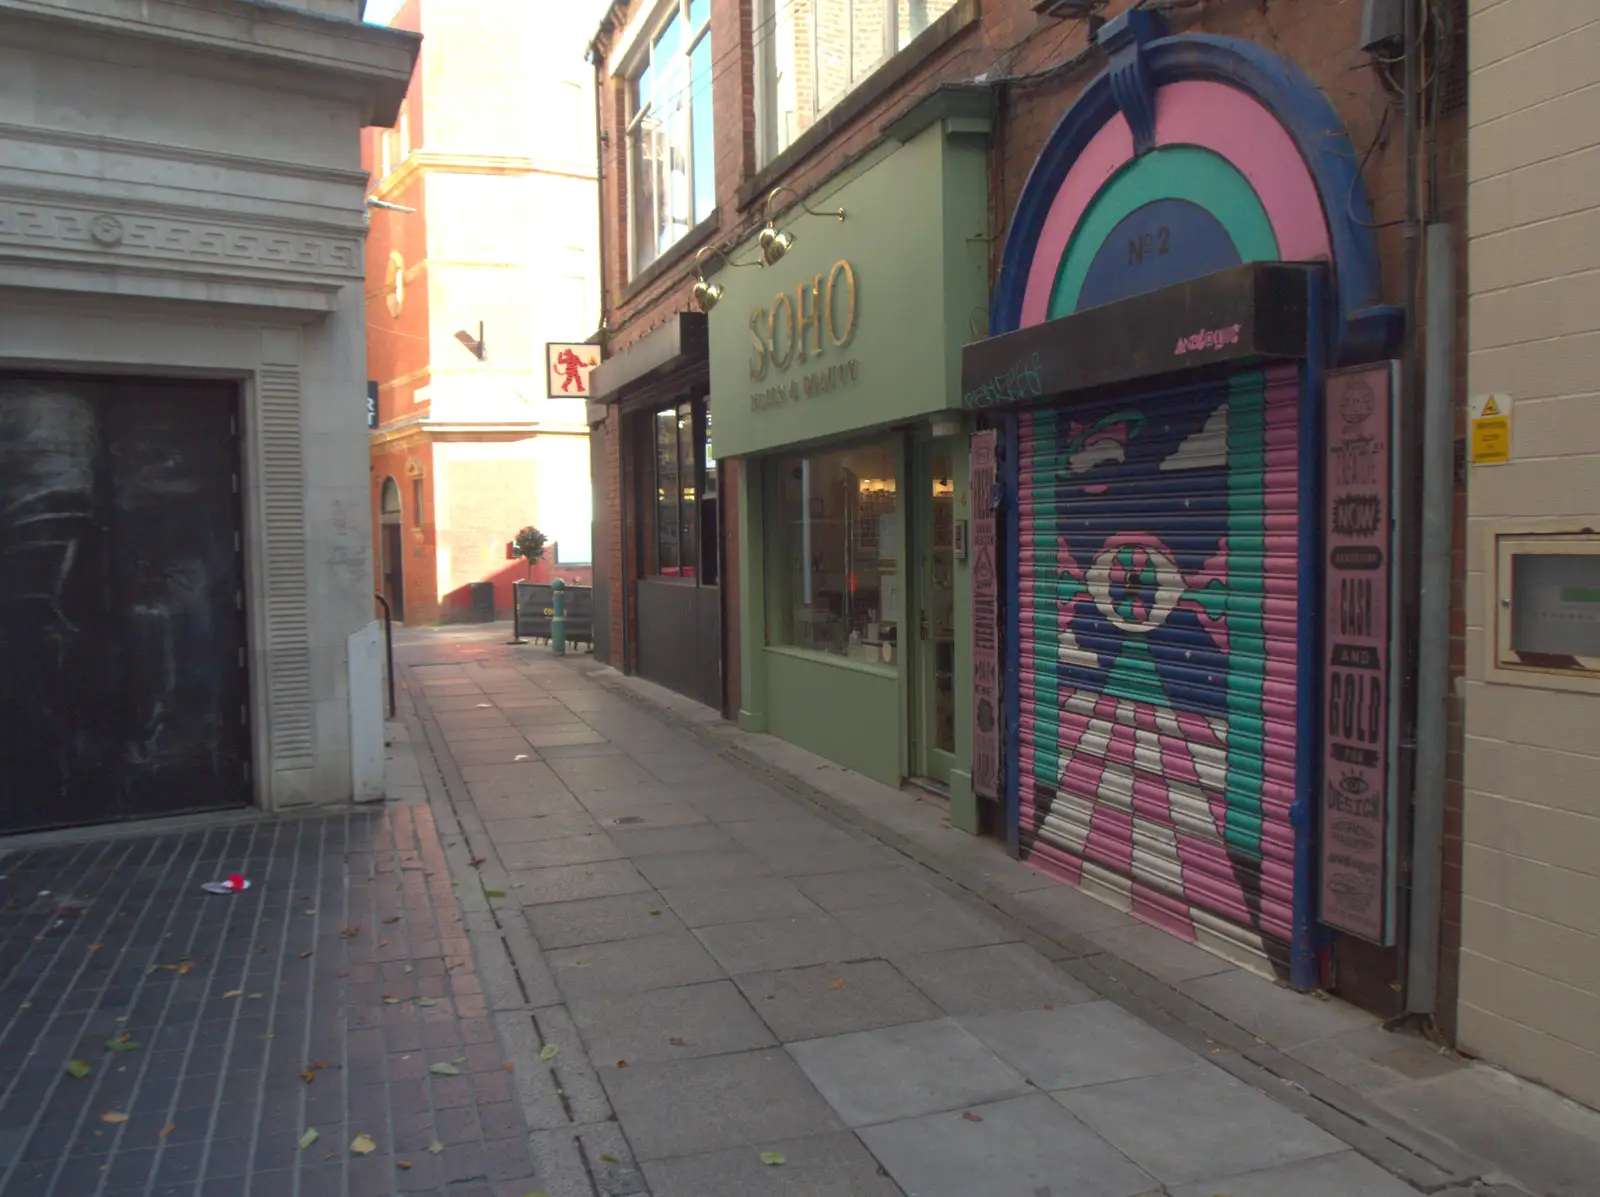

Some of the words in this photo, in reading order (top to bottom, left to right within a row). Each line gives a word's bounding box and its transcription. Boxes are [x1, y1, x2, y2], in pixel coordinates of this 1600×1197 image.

[749, 259, 855, 381] SOHO
[1340, 647, 1371, 664] AND
[1329, 671, 1382, 744] GOLD
[1327, 778, 1380, 821] DESIGN
